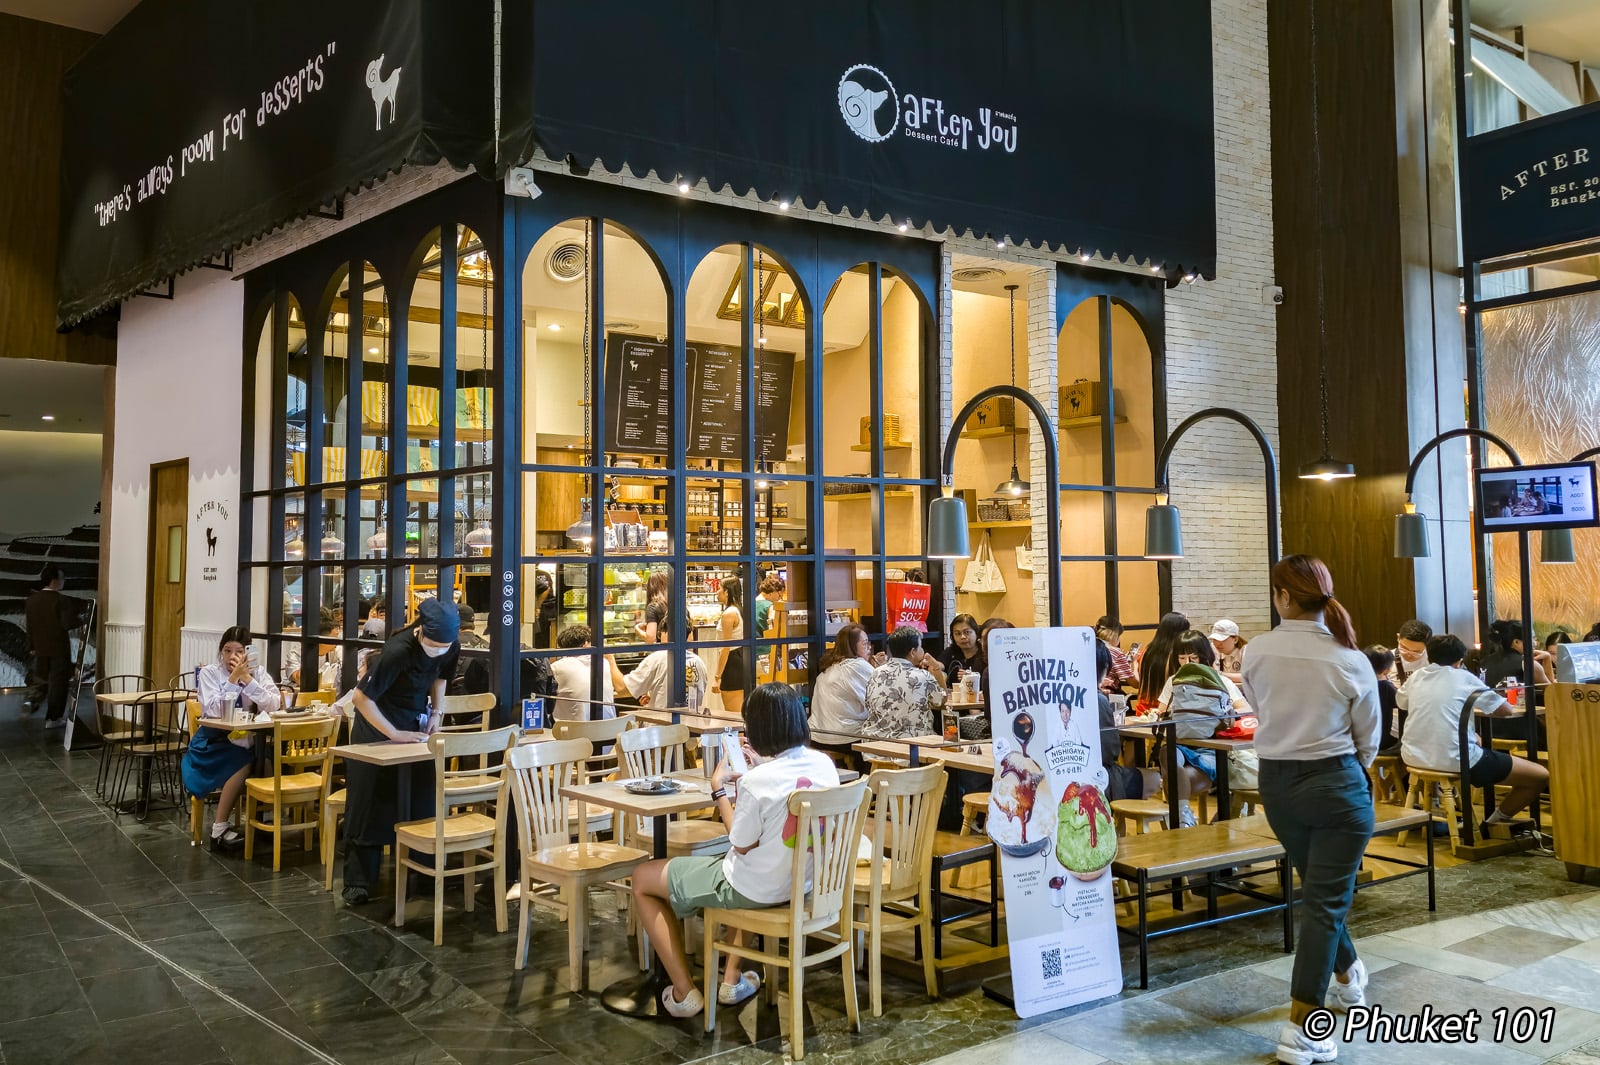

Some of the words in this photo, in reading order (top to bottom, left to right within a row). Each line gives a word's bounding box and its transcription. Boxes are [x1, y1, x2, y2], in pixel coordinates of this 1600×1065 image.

[222, 107, 247, 151] For
[905, 127, 938, 143] Dessert
[940, 135, 959, 147] Café
[1499, 148, 1590, 201] AFTER
[196, 500, 214, 522] AFTER
[217, 502, 229, 521] YOU
[902, 597, 927, 610] MINI
[1005, 650, 1033, 662] From
[1017, 658, 1067, 684] GINZA
[1068, 661, 1080, 678] to
[1002, 682, 1088, 715] BANGKOK
[1051, 747, 1085, 758] NISHIGAYA
[1051, 755, 1085, 765] YOSHINORI
